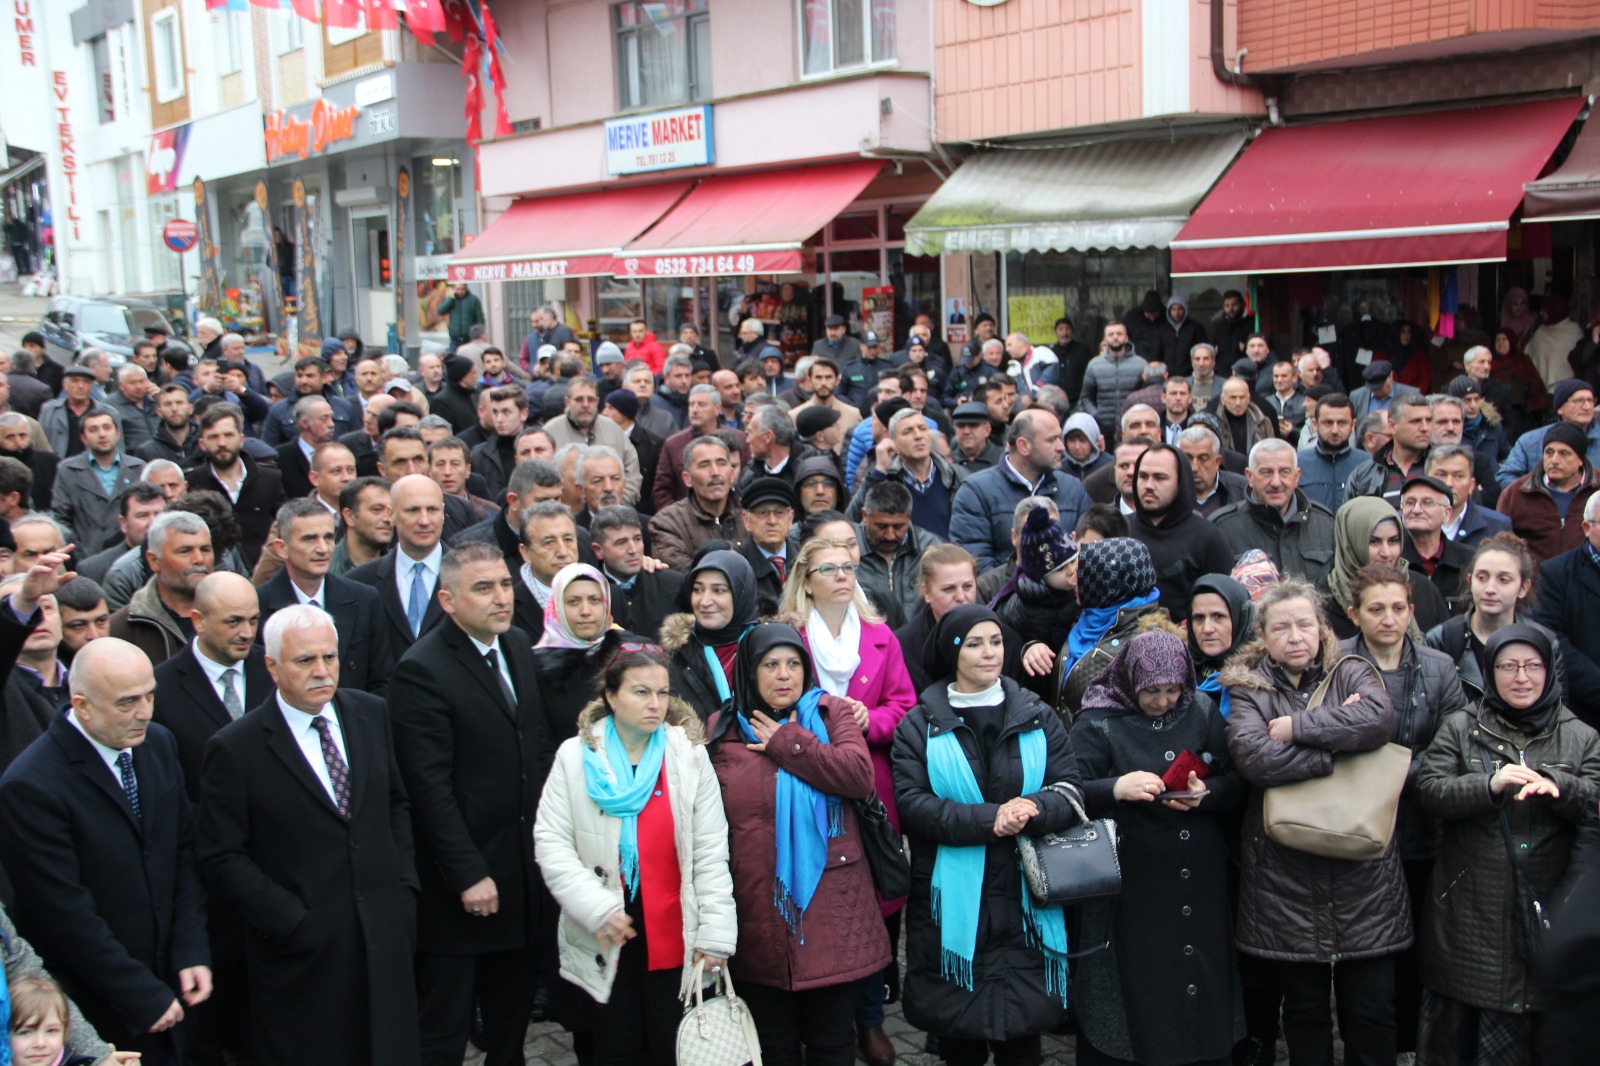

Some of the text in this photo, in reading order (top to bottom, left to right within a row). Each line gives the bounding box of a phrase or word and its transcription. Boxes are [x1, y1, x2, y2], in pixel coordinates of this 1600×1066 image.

[53, 71, 69, 102] EV
[608, 114, 702, 152] MERVE MARKET
[944, 230, 1006, 250] EMRE
[474, 261, 568, 280] MERVE MARKET
[655, 254, 755, 274] 0532 734 64 49
